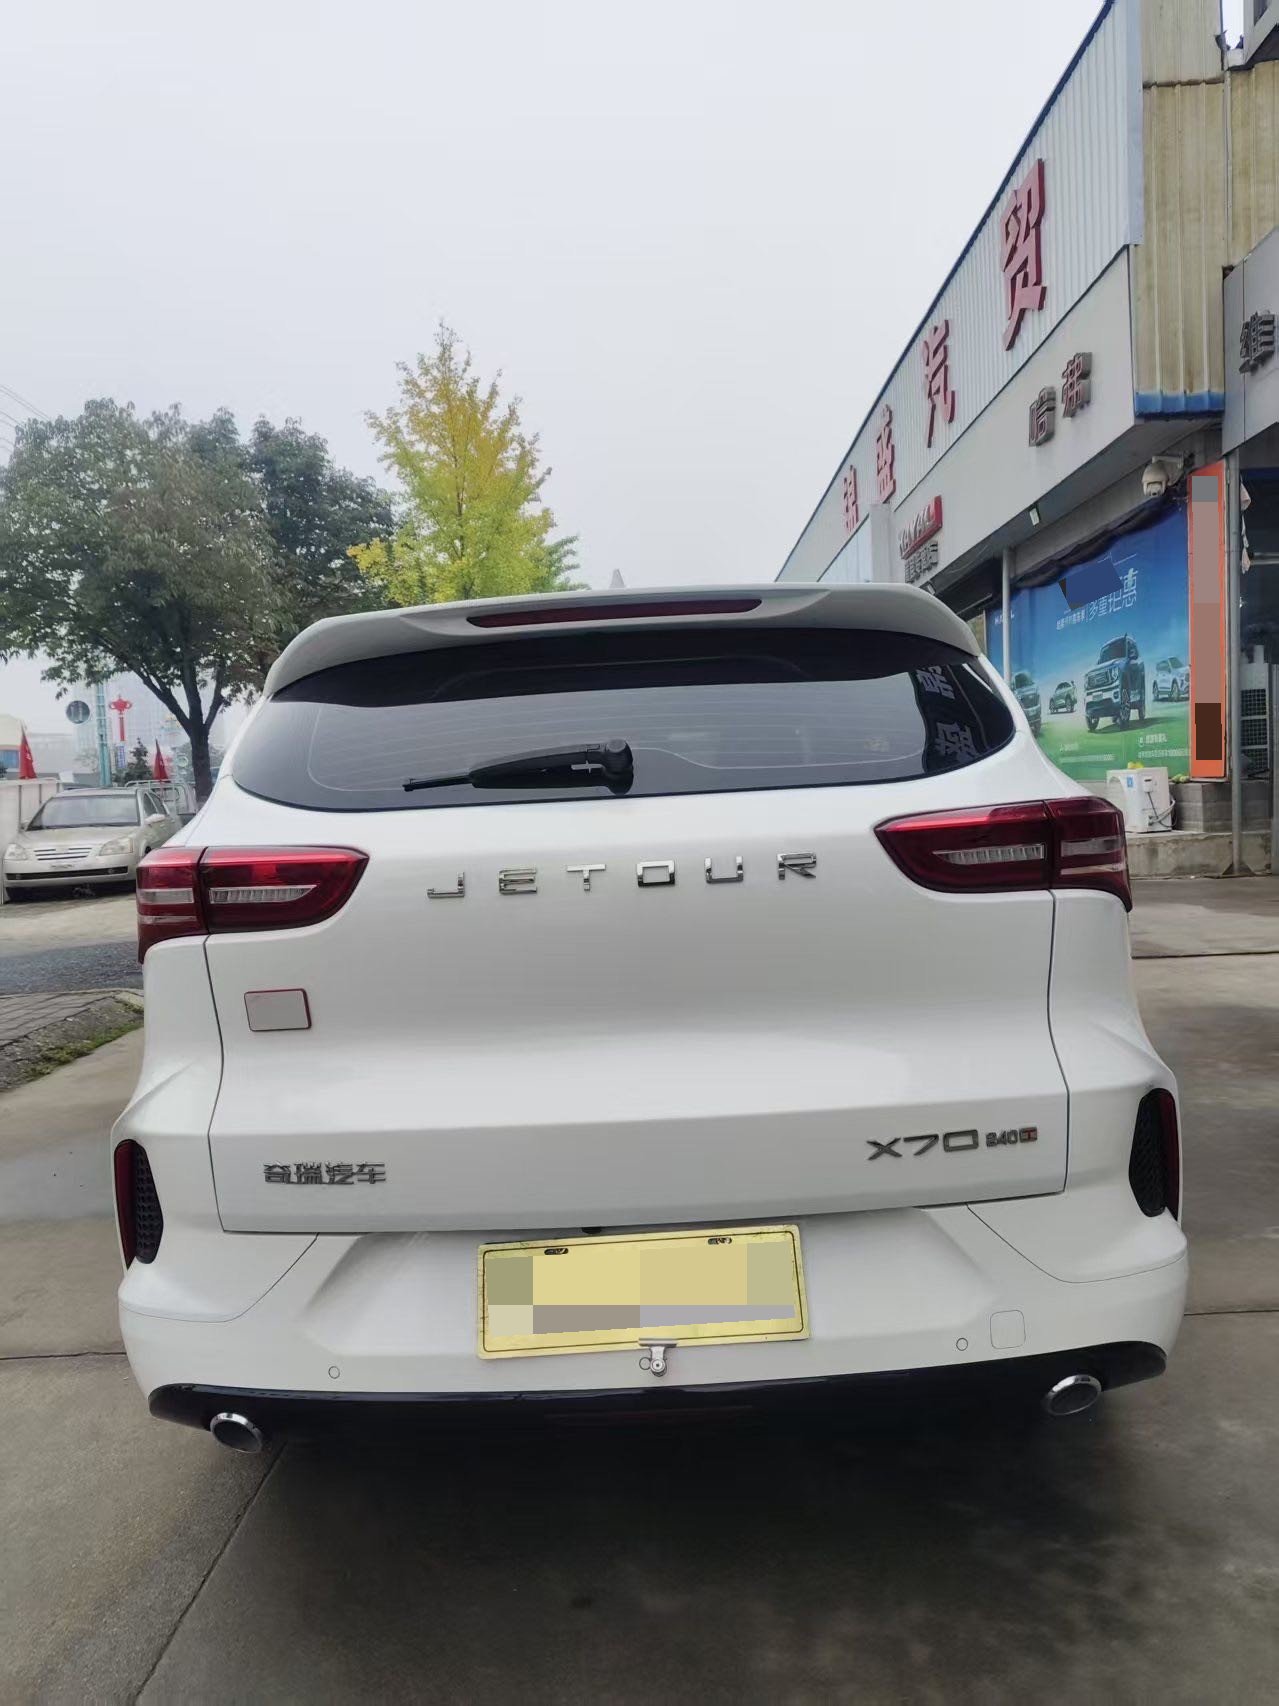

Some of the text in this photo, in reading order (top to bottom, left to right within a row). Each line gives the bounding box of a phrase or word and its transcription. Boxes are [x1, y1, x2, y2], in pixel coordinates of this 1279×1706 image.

[426, 851, 817, 899] JETOUR
[866, 1129, 979, 1161] X70
[263, 1160, 386, 1185] 奇瑞汽车
